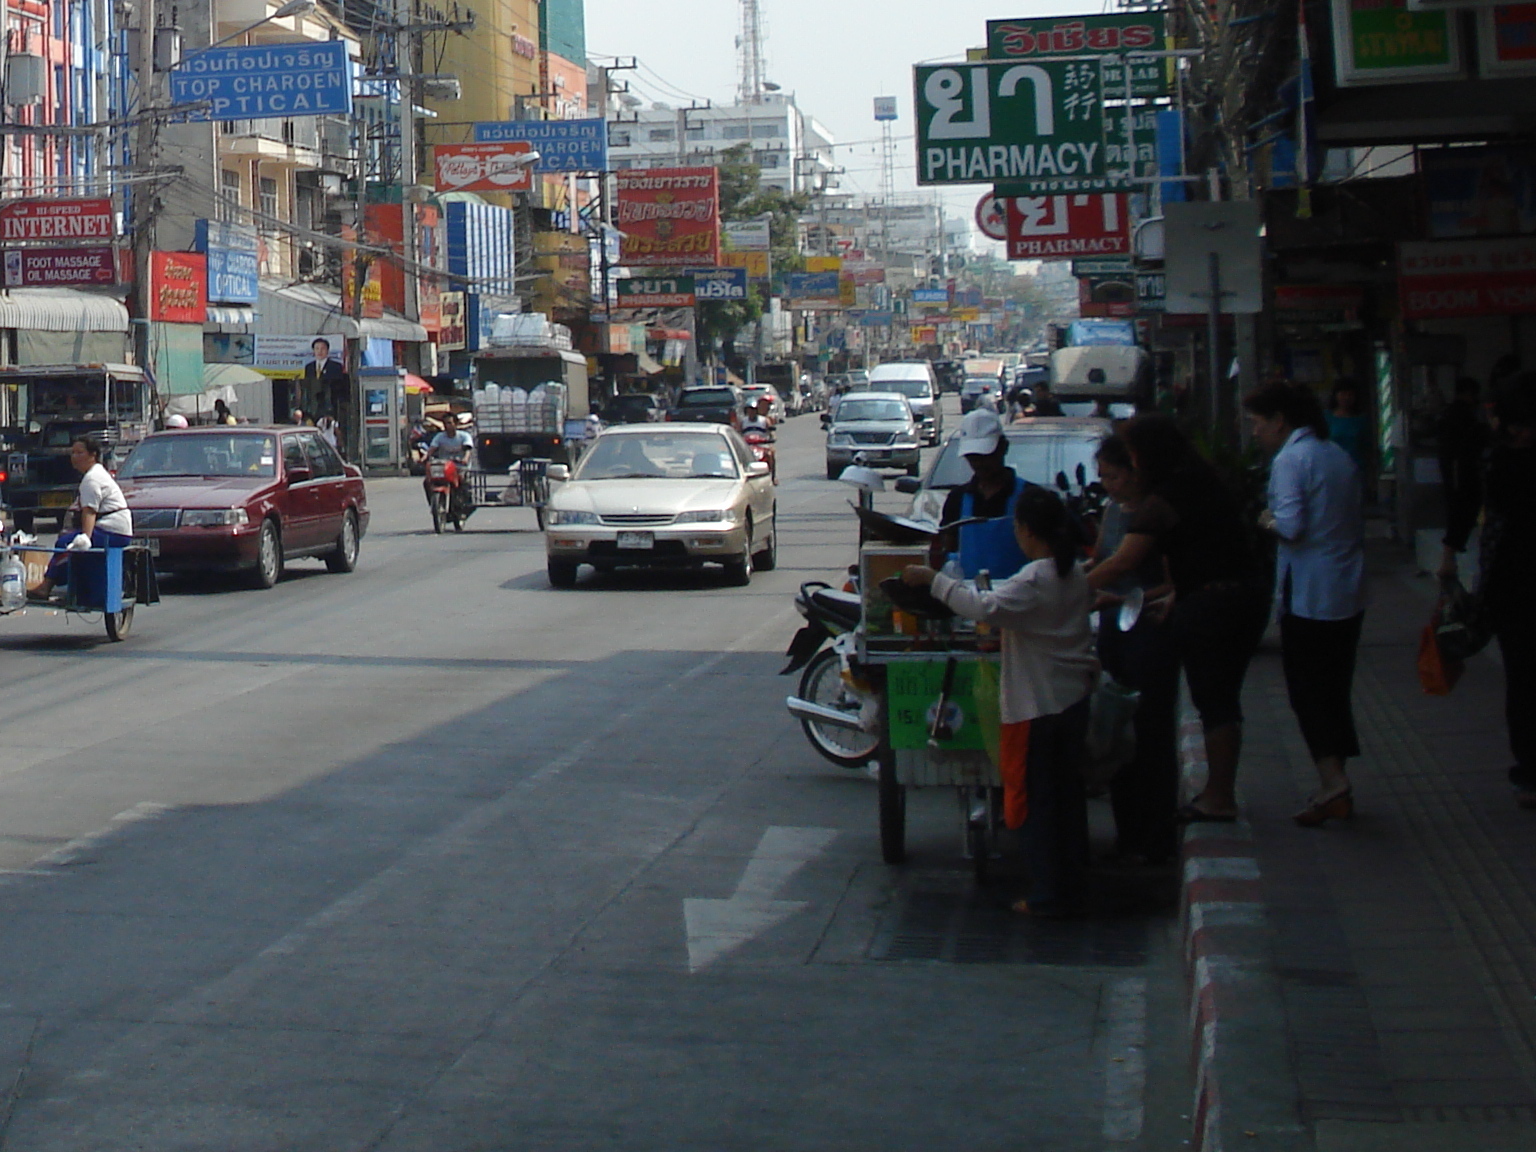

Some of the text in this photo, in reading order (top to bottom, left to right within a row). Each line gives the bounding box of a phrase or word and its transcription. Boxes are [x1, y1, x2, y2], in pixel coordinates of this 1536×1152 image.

[994, 21, 1156, 55] วิเชียร
[181, 50, 334, 73] แว่นท็อปเจริญ
[176, 71, 341, 96] TOP CHAROEN
[215, 92, 330, 114] PTICAL
[924, 64, 1055, 140] ยา
[533, 140, 601, 154] HAROEN
[539, 156, 593, 169] ICAL
[927, 142, 1099, 180] PHARMACY
[4, 214, 110, 238] INTERNET
[1016, 236, 1124, 255] PHARMACY
[27, 255, 102, 268] FOOT MASSAGE
[27, 269, 92, 282] OIL MASSAGE
[216, 272, 252, 297] OPTICAL
[645, 279, 677, 294] ยา
